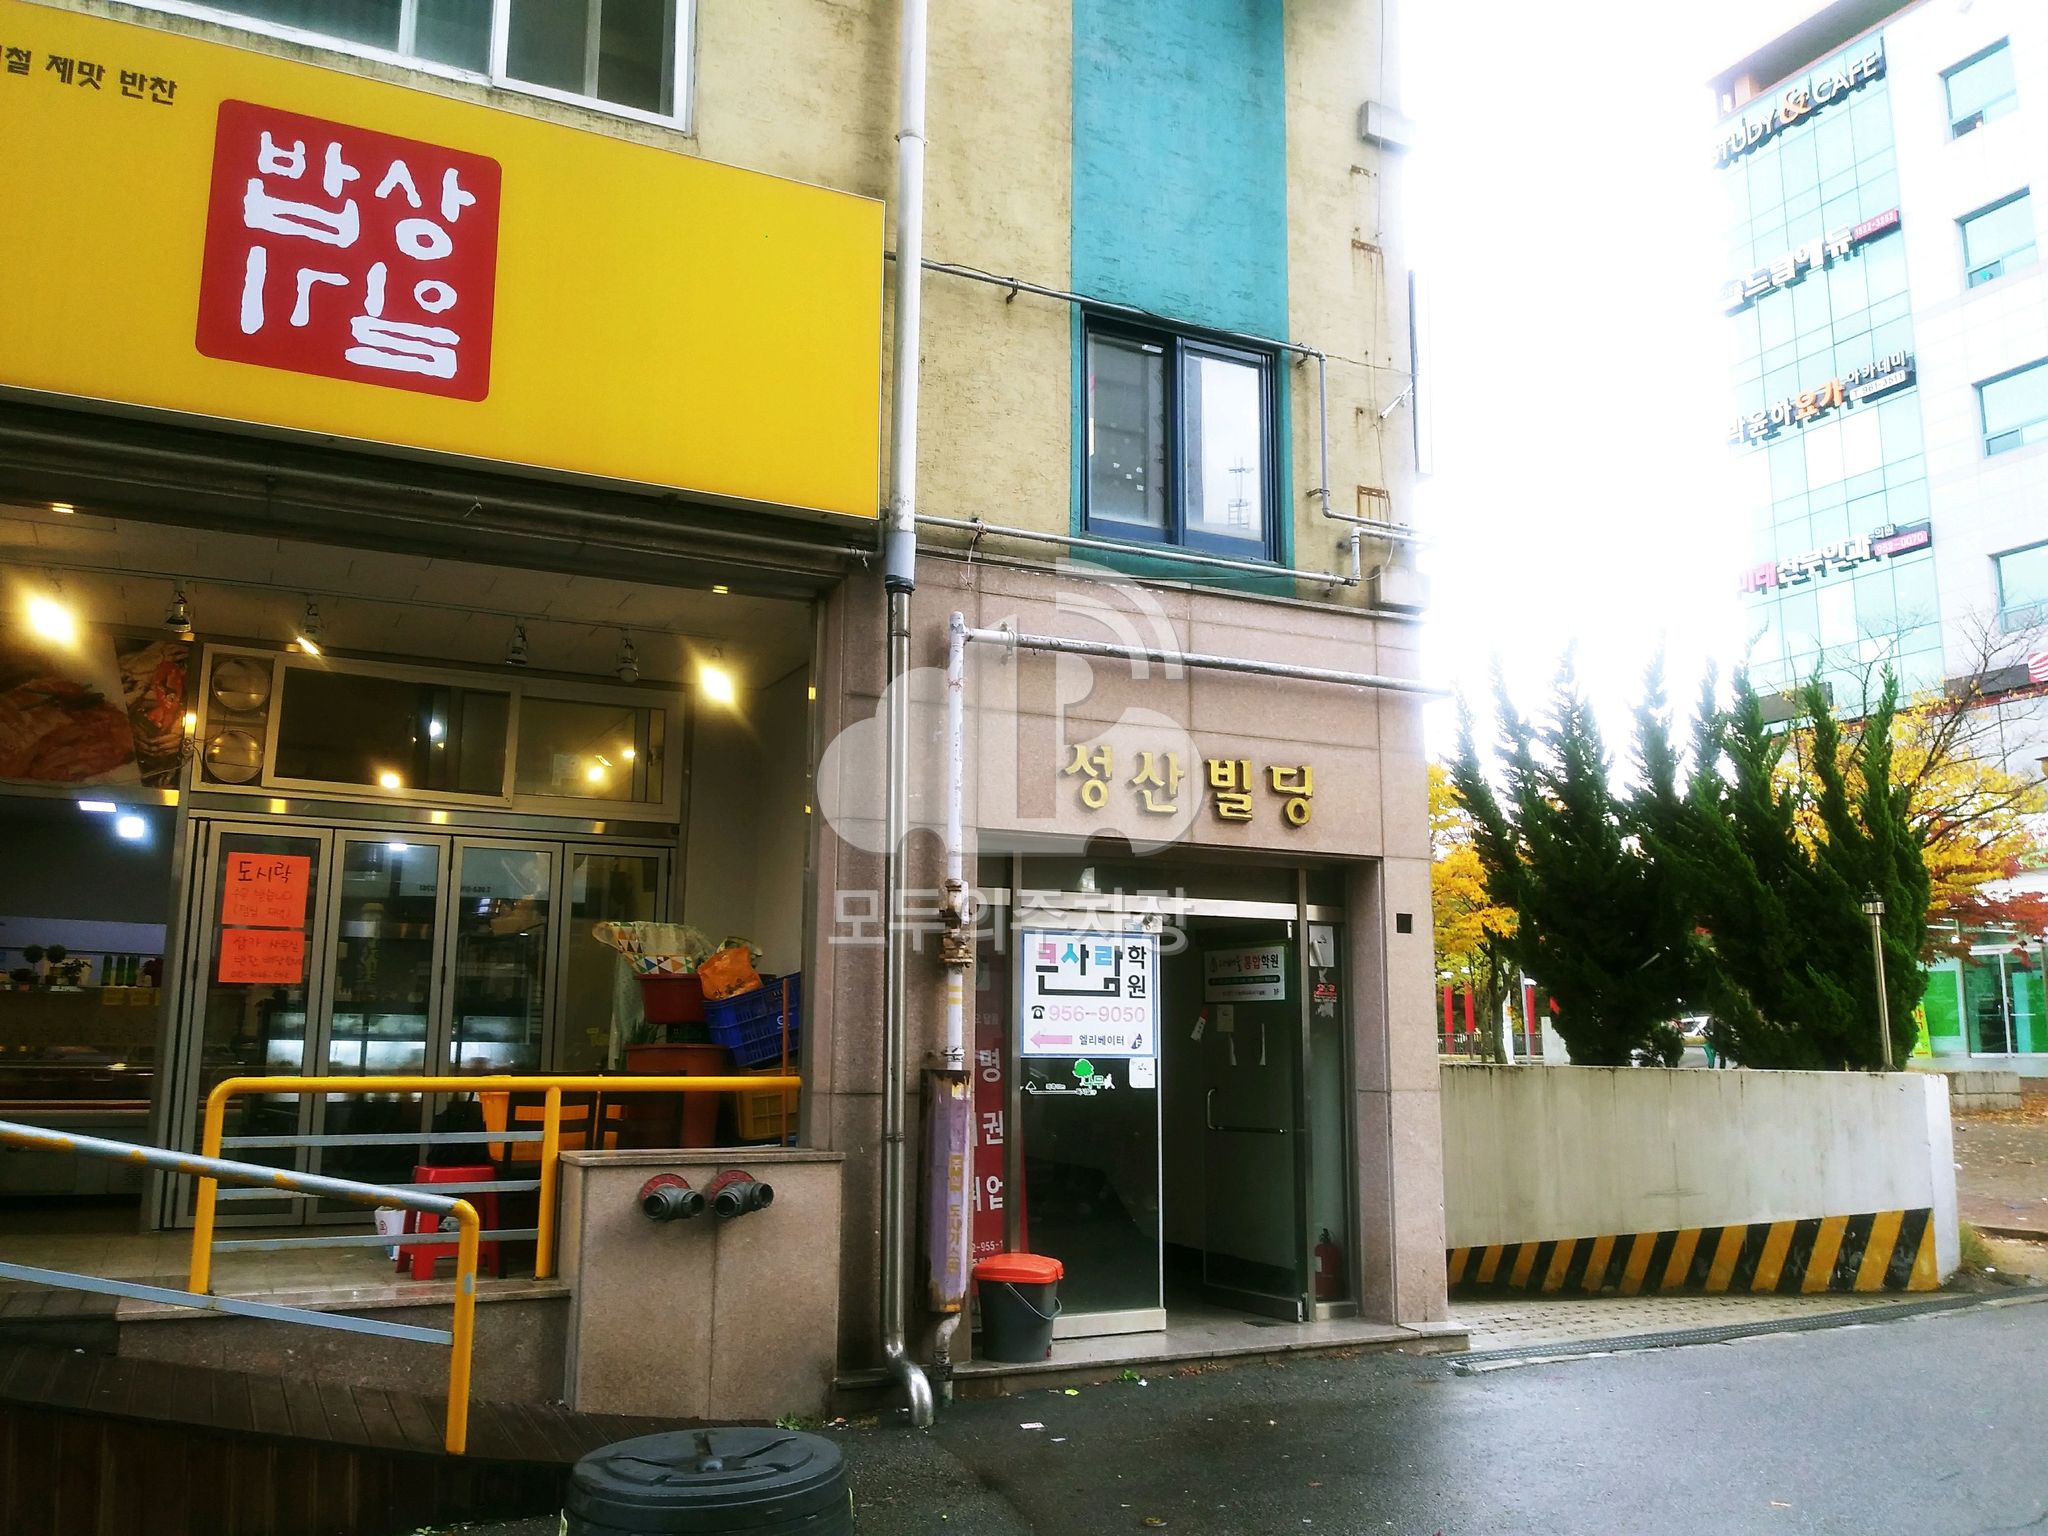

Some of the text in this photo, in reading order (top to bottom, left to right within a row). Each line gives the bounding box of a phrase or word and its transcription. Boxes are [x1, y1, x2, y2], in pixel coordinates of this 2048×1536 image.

[0, 45, 178, 107] 철 제맛 반찬
[1812, 51, 1879, 104] CAFE
[1847, 350, 1905, 385] 아카데미
[1063, 743, 1314, 828] 성산빌딩
[238, 860, 293, 884] 도시락
[1127, 945, 1147, 999] 학원
